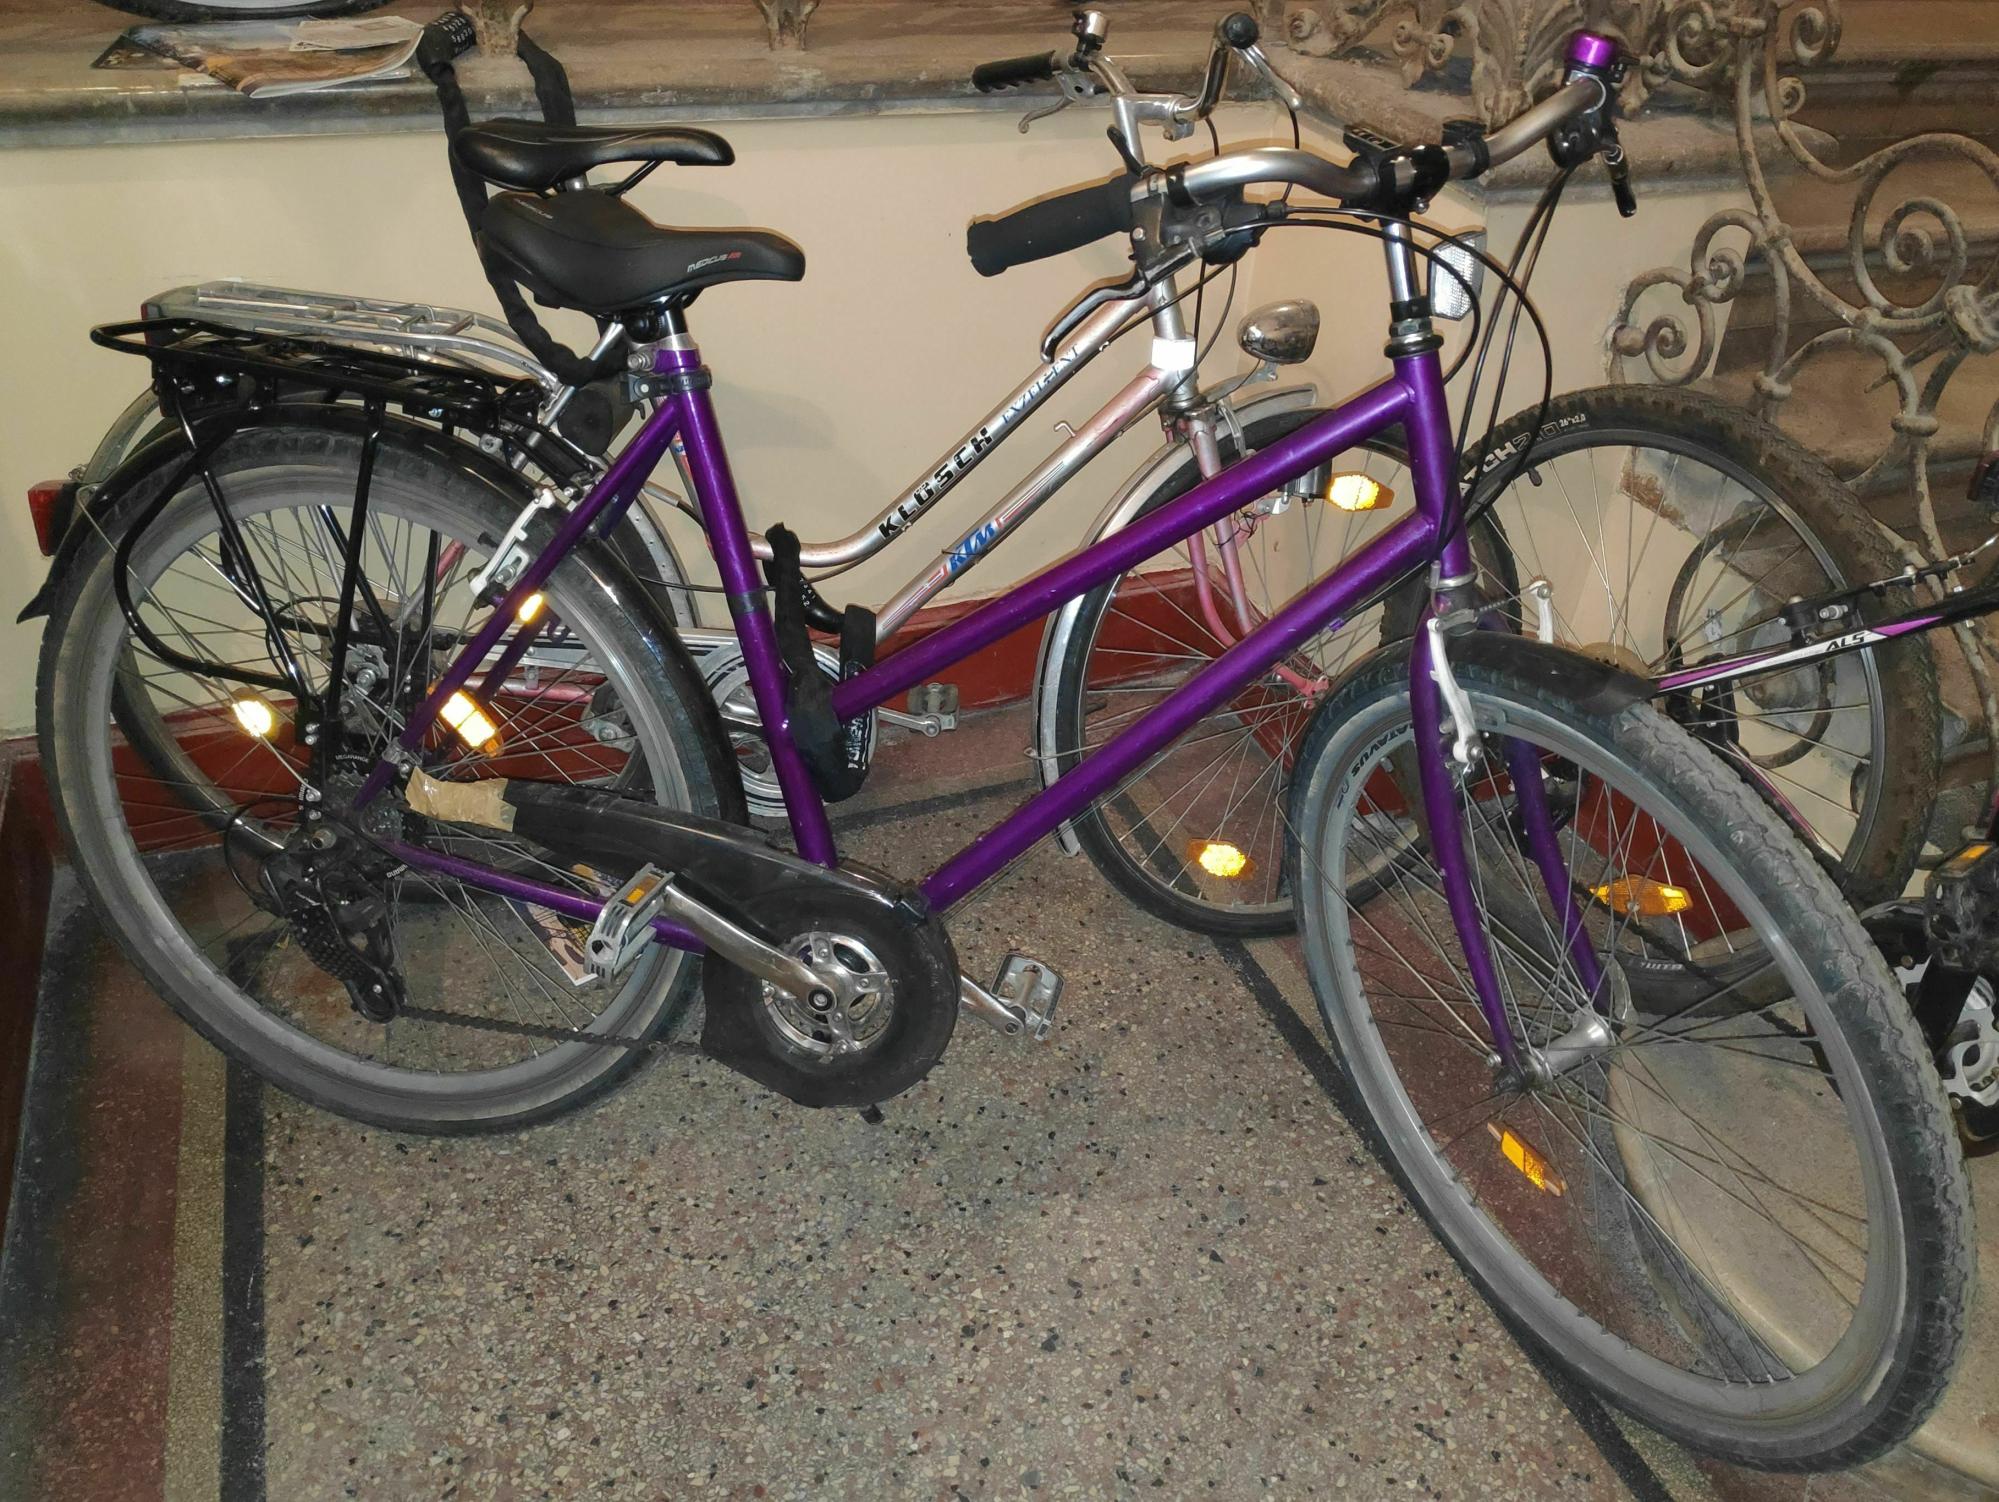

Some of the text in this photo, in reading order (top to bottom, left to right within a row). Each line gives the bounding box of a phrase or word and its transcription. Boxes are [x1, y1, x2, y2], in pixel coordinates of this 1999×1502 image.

[1459, 441, 1518, 498] ATCH
[949, 522, 995, 572] KTM
[1825, 631, 1866, 652] ALS
[1352, 722, 1415, 778] ATAVUS
